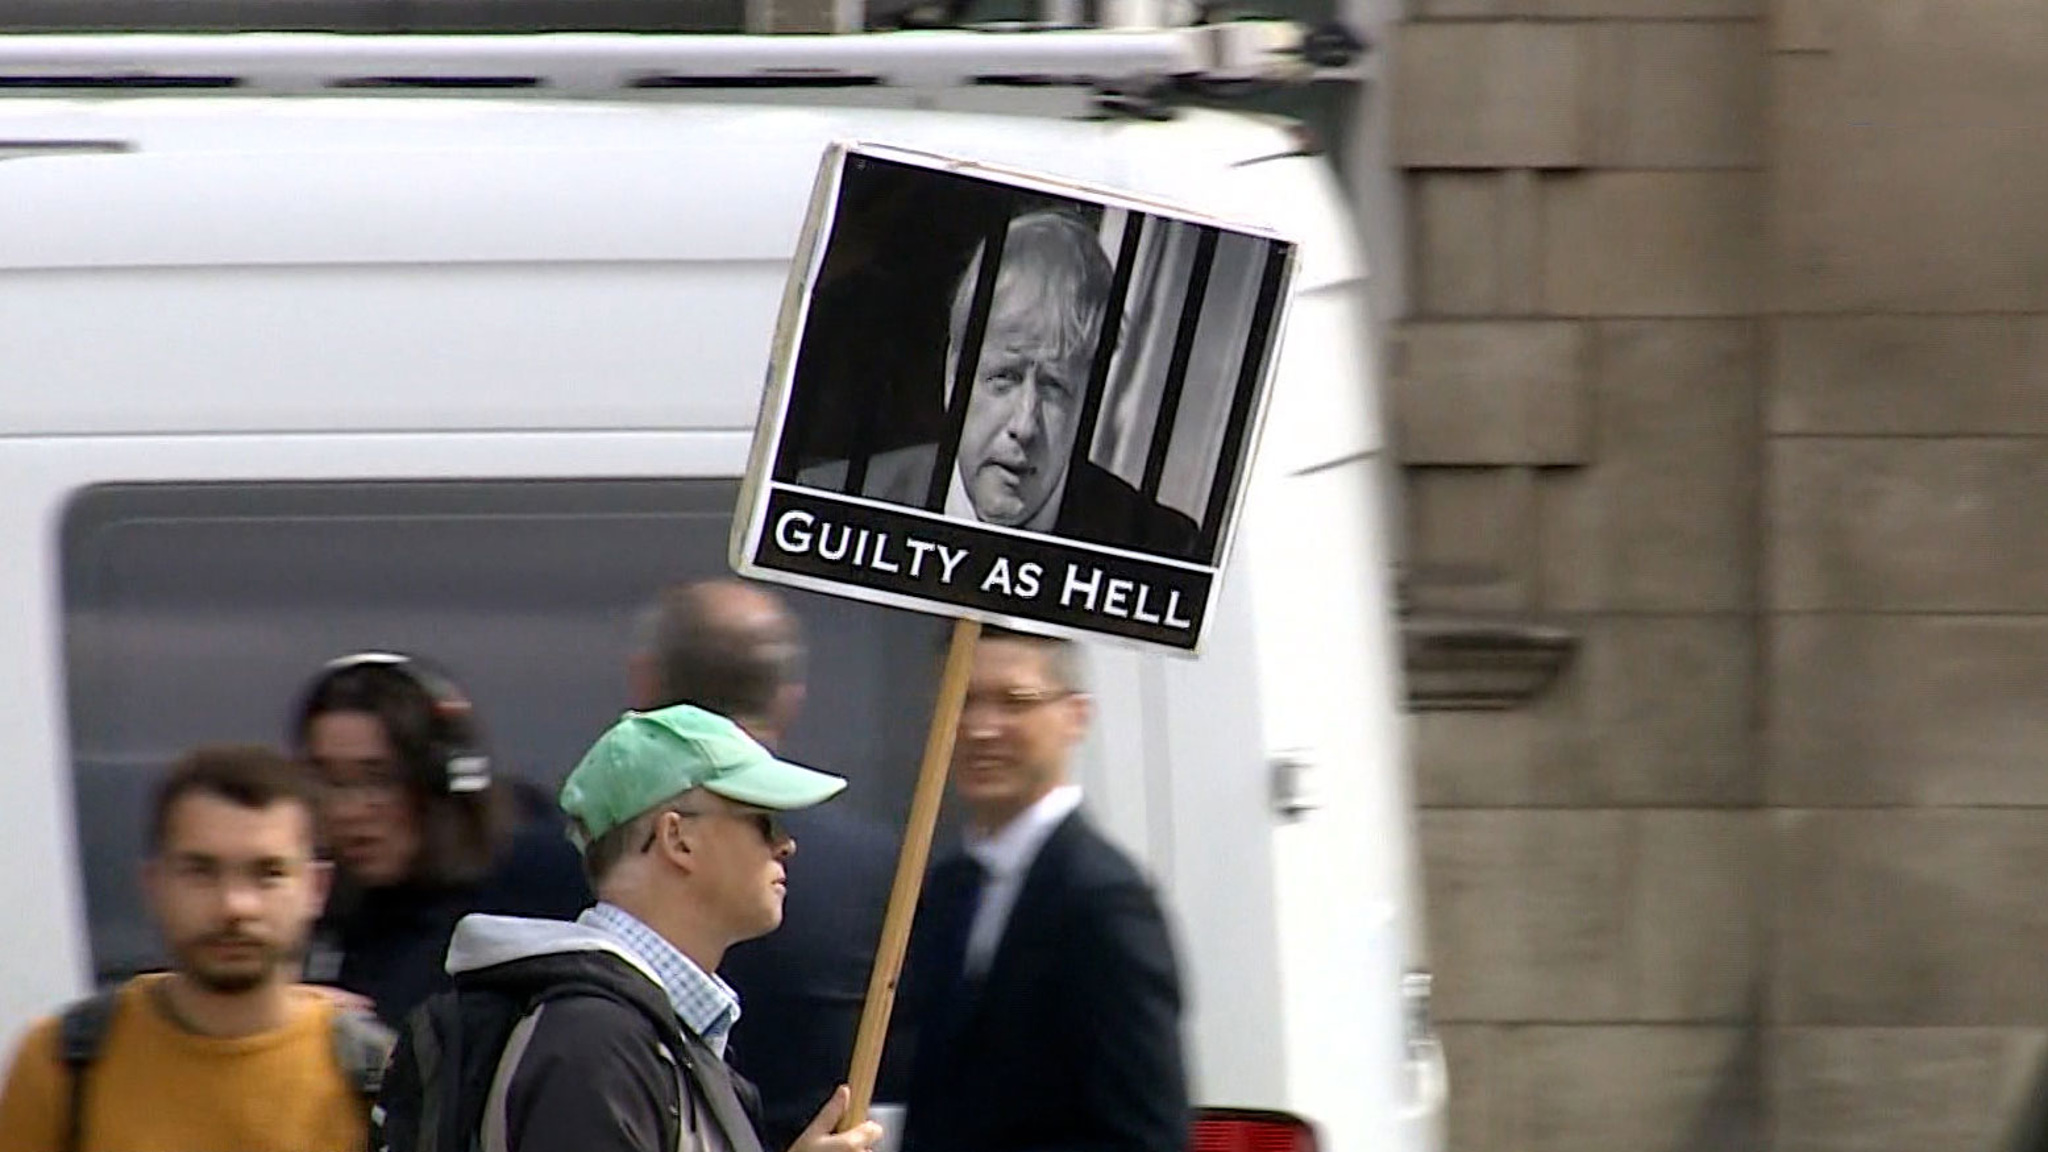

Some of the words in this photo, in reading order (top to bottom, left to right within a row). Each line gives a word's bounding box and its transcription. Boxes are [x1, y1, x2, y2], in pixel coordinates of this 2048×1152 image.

[774, 509, 969, 583] GUILTY
[980, 557, 1044, 598] AS
[1060, 563, 1191, 630] HELL
